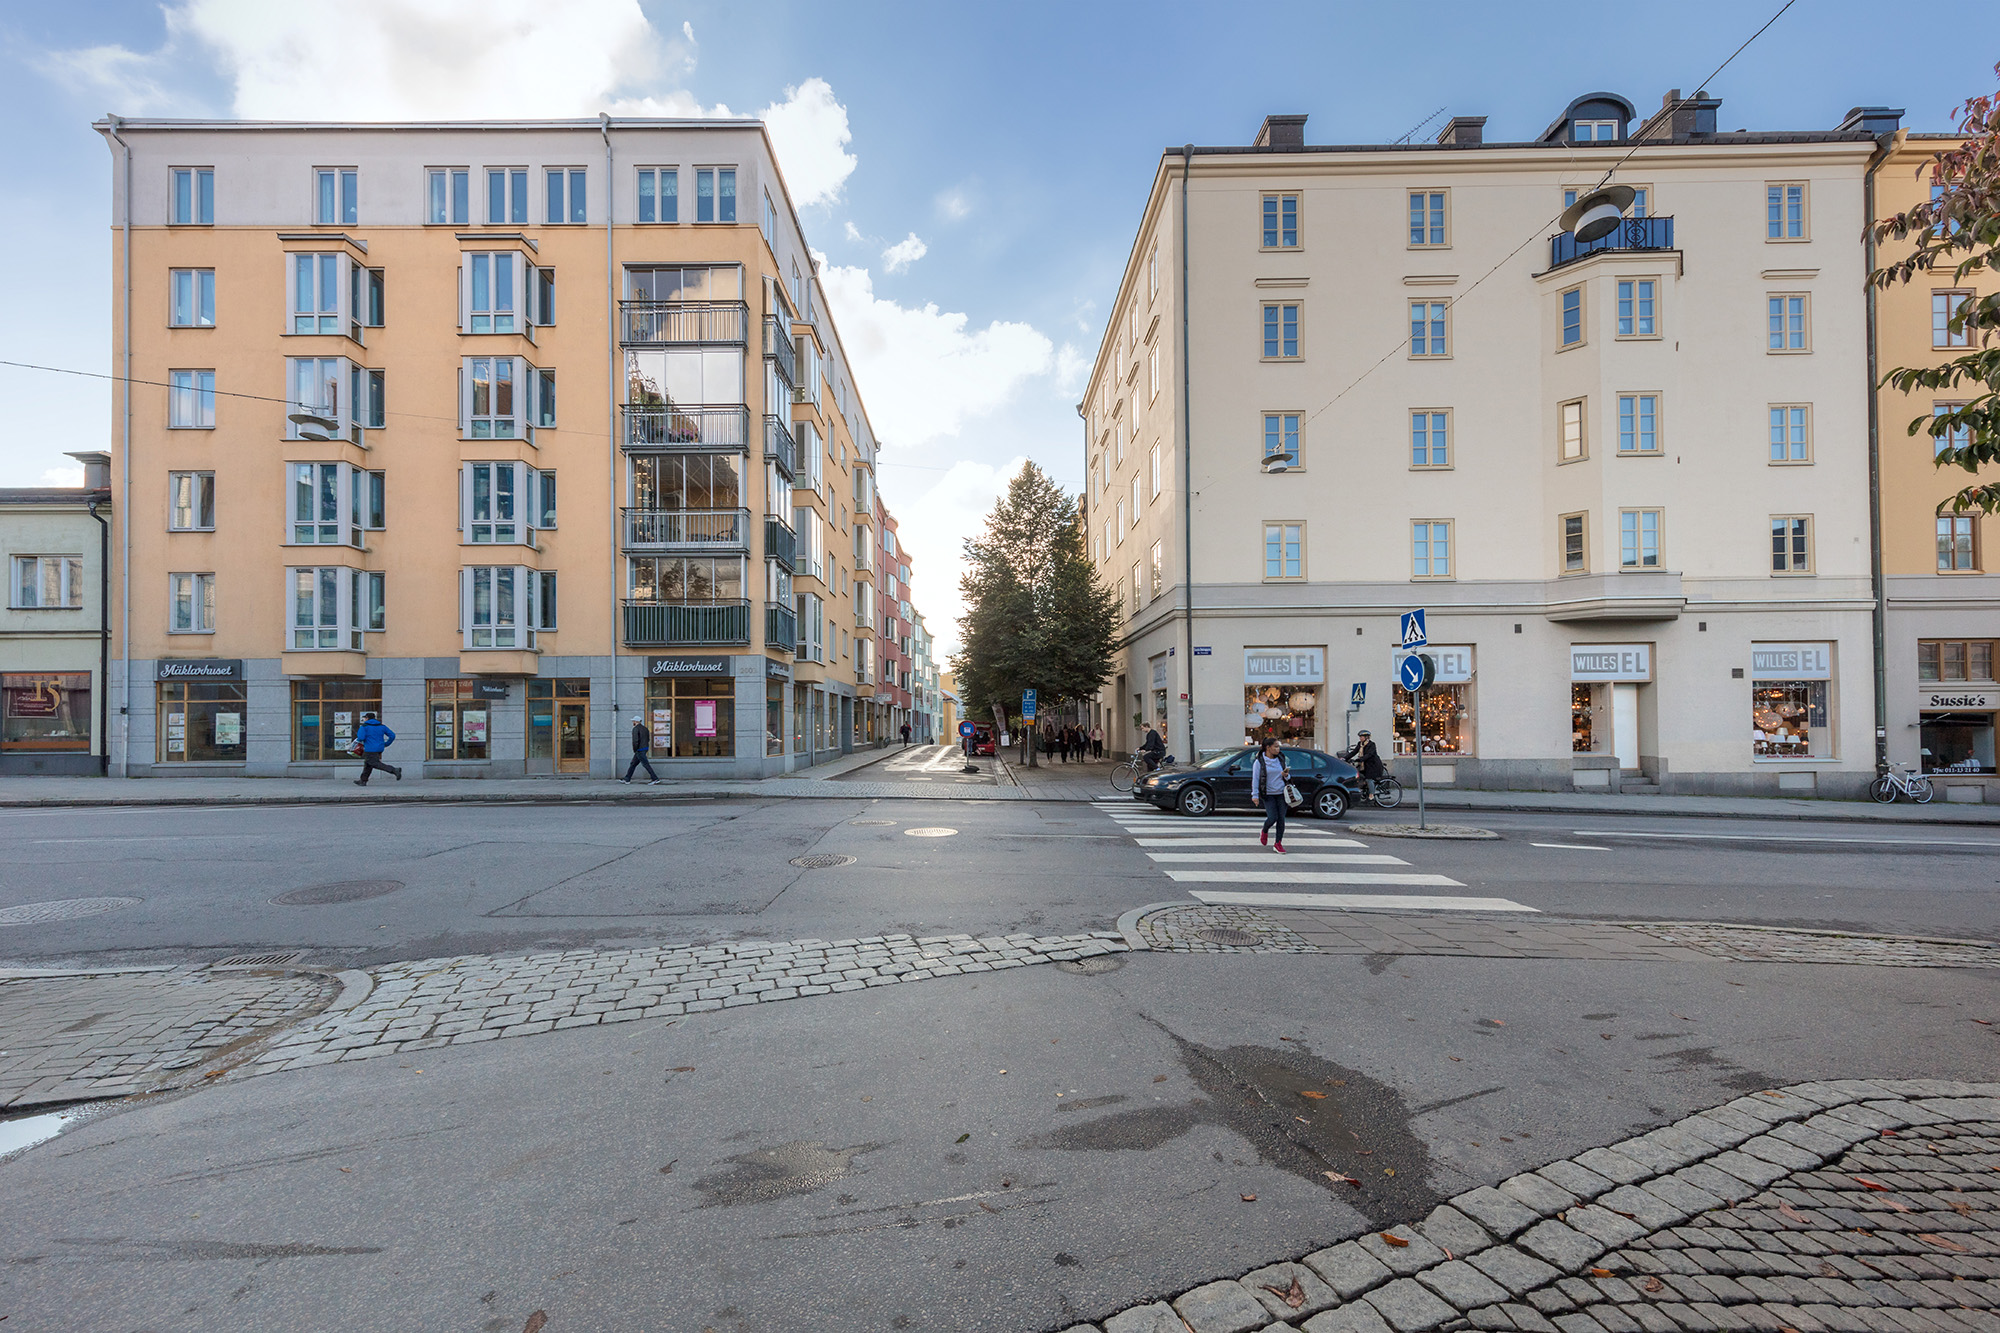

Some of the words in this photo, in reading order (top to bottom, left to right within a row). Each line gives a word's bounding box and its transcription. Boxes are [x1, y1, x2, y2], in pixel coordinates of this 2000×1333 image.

[652, 660, 723, 674] Mäklarhuset
[1249, 658, 1290, 673] WILLES
[1295, 655, 1320, 675] EL
[1443, 654, 1467, 674] EL
[1575, 656, 1617, 670] WILLES
[1622, 652, 1646, 673] EL
[1755, 653, 1796, 668] WILLES
[1802, 650, 1826, 671] EL
[160, 664, 232, 678] Mäklarhuset
[30, 680, 63, 712] 15
[1026, 690, 1034, 699] P
